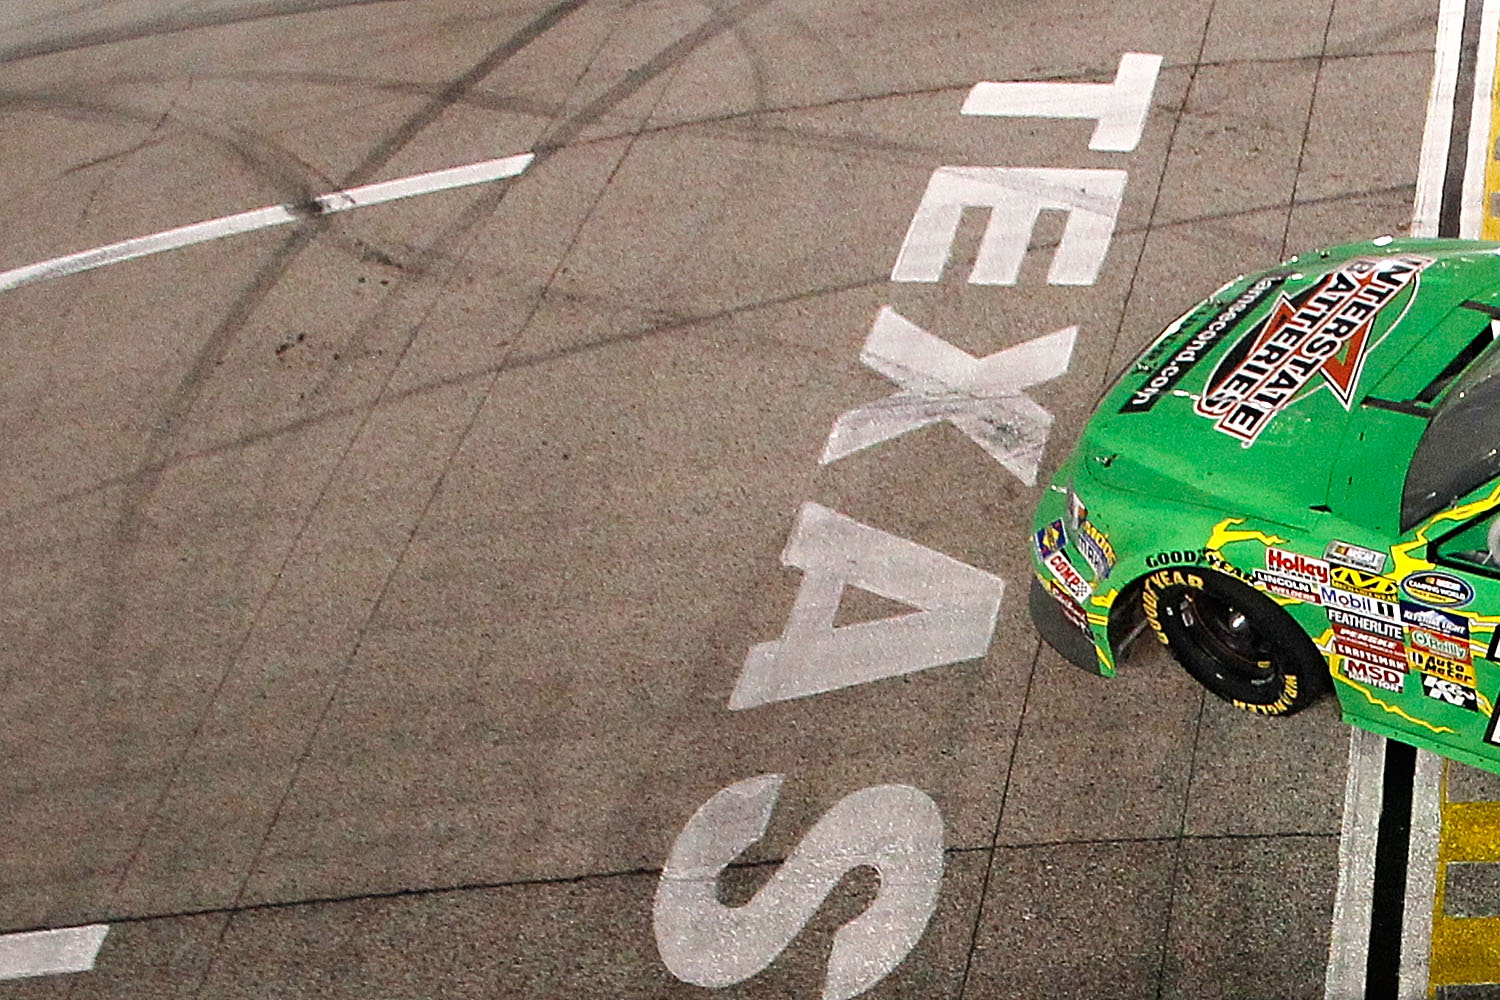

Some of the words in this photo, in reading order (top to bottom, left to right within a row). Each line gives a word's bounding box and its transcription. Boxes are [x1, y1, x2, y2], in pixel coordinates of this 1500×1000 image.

[1202, 260, 1377, 413] BATTERIES
[1230, 257, 1422, 432] INTERSTATE
[652, 52, 1163, 1000] TEXAS
[1050, 555, 1081, 587] COMP
[1268, 549, 1328, 583] Holley
[1258, 571, 1310, 593] LINCOLN
[1142, 570, 1205, 645] GOODYEAR
[1321, 587, 1371, 611] Mobil
[1328, 610, 1403, 640] FEATHERLITE
[1347, 659, 1400, 685] MSD
[1425, 664, 1473, 683] Meter
[1427, 655, 1465, 673] Auto
